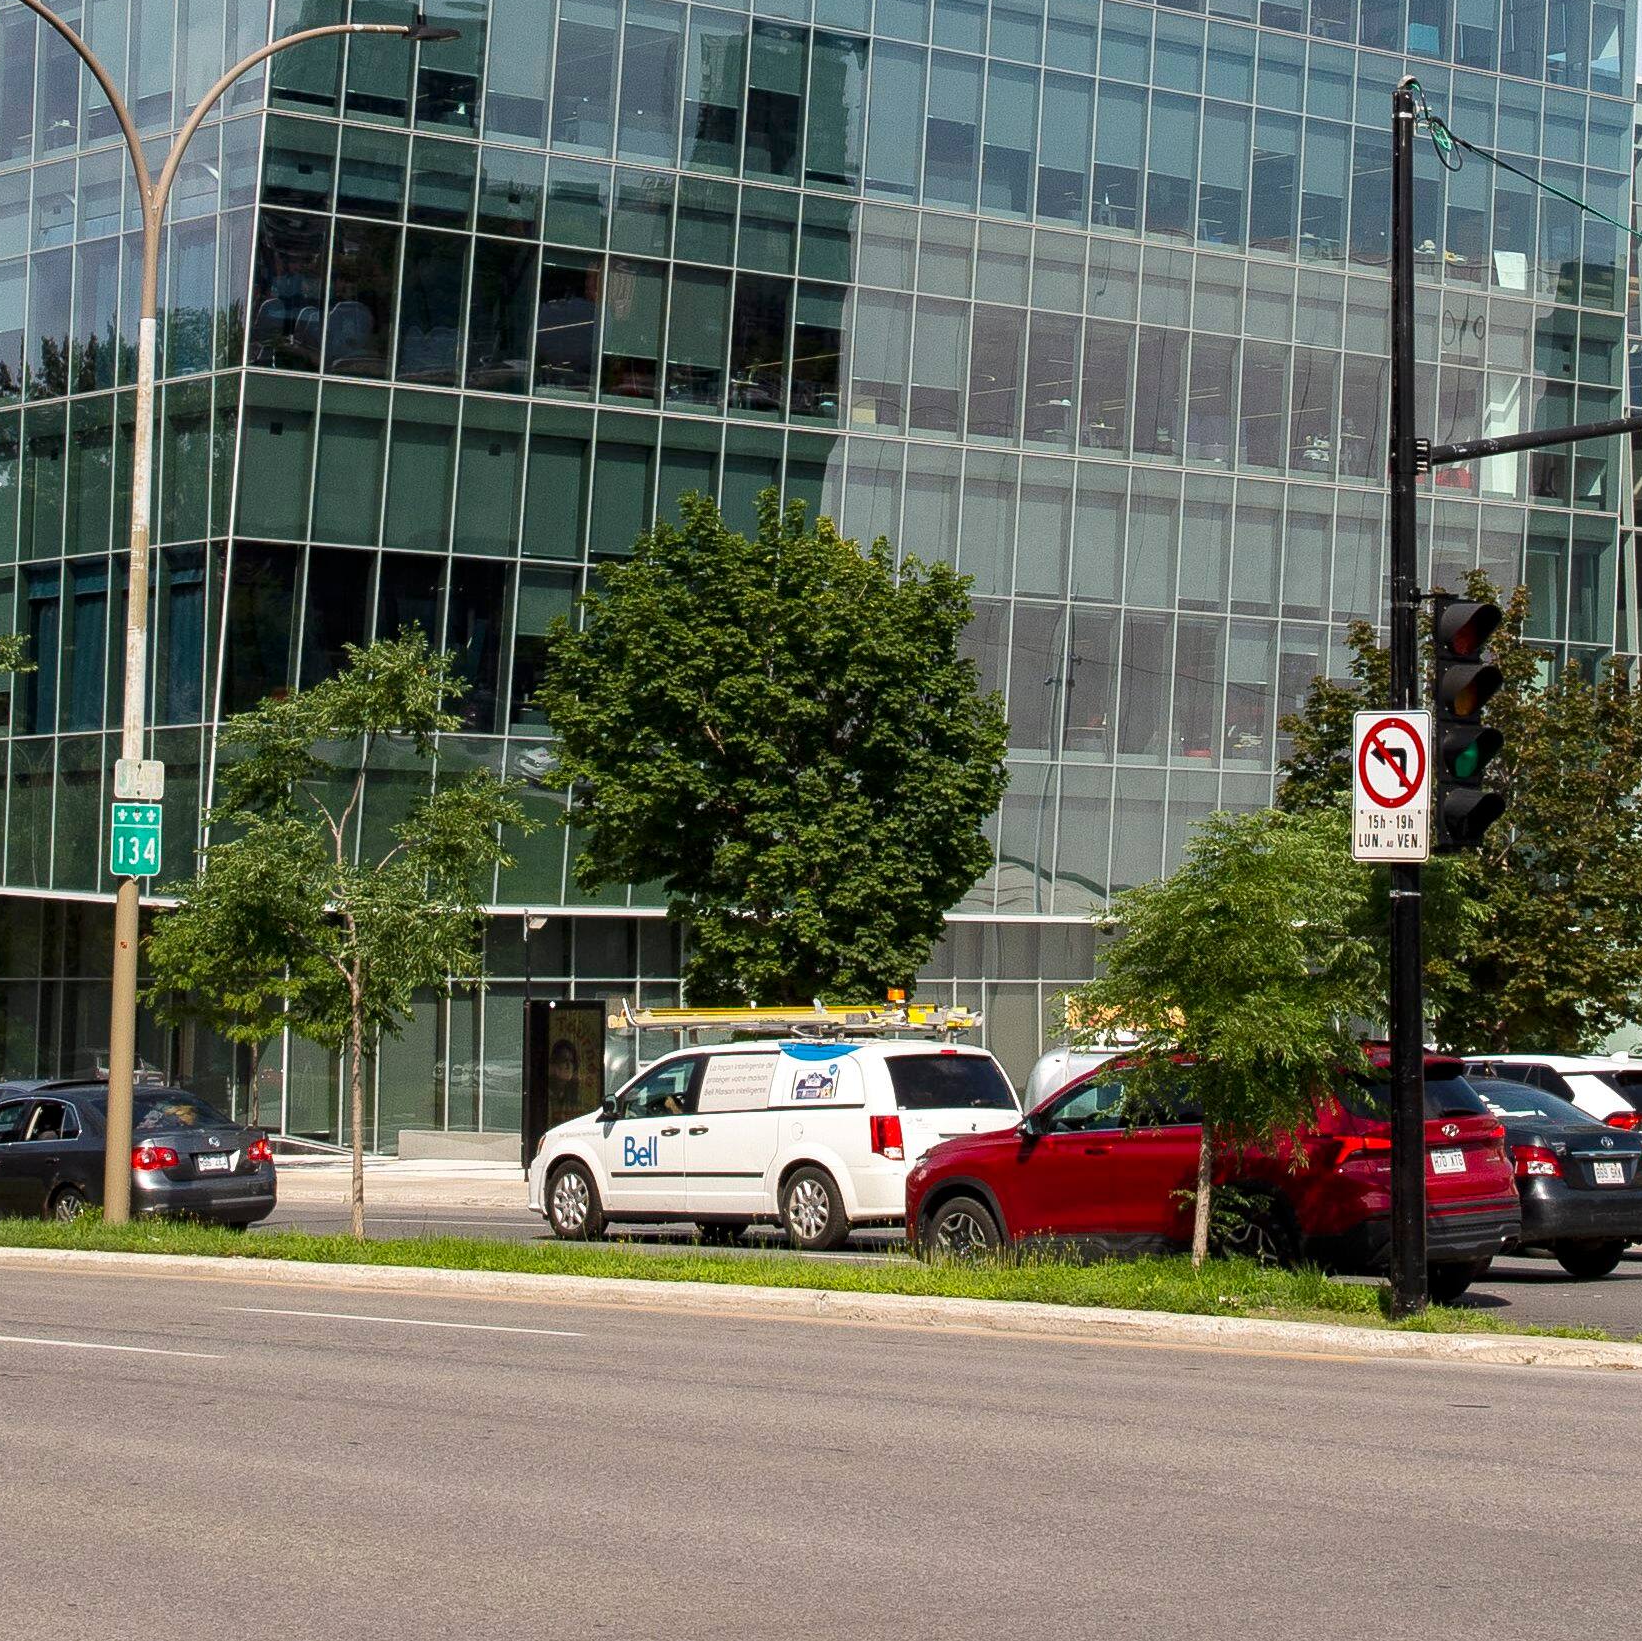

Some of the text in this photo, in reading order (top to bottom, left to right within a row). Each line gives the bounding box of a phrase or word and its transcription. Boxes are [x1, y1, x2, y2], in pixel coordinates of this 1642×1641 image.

[118, 836, 156, 866] 134
[1358, 833, 1383, 848] LUN.
[1397, 833, 1423, 848] VEN.
[624, 1136, 658, 1167] Bell
